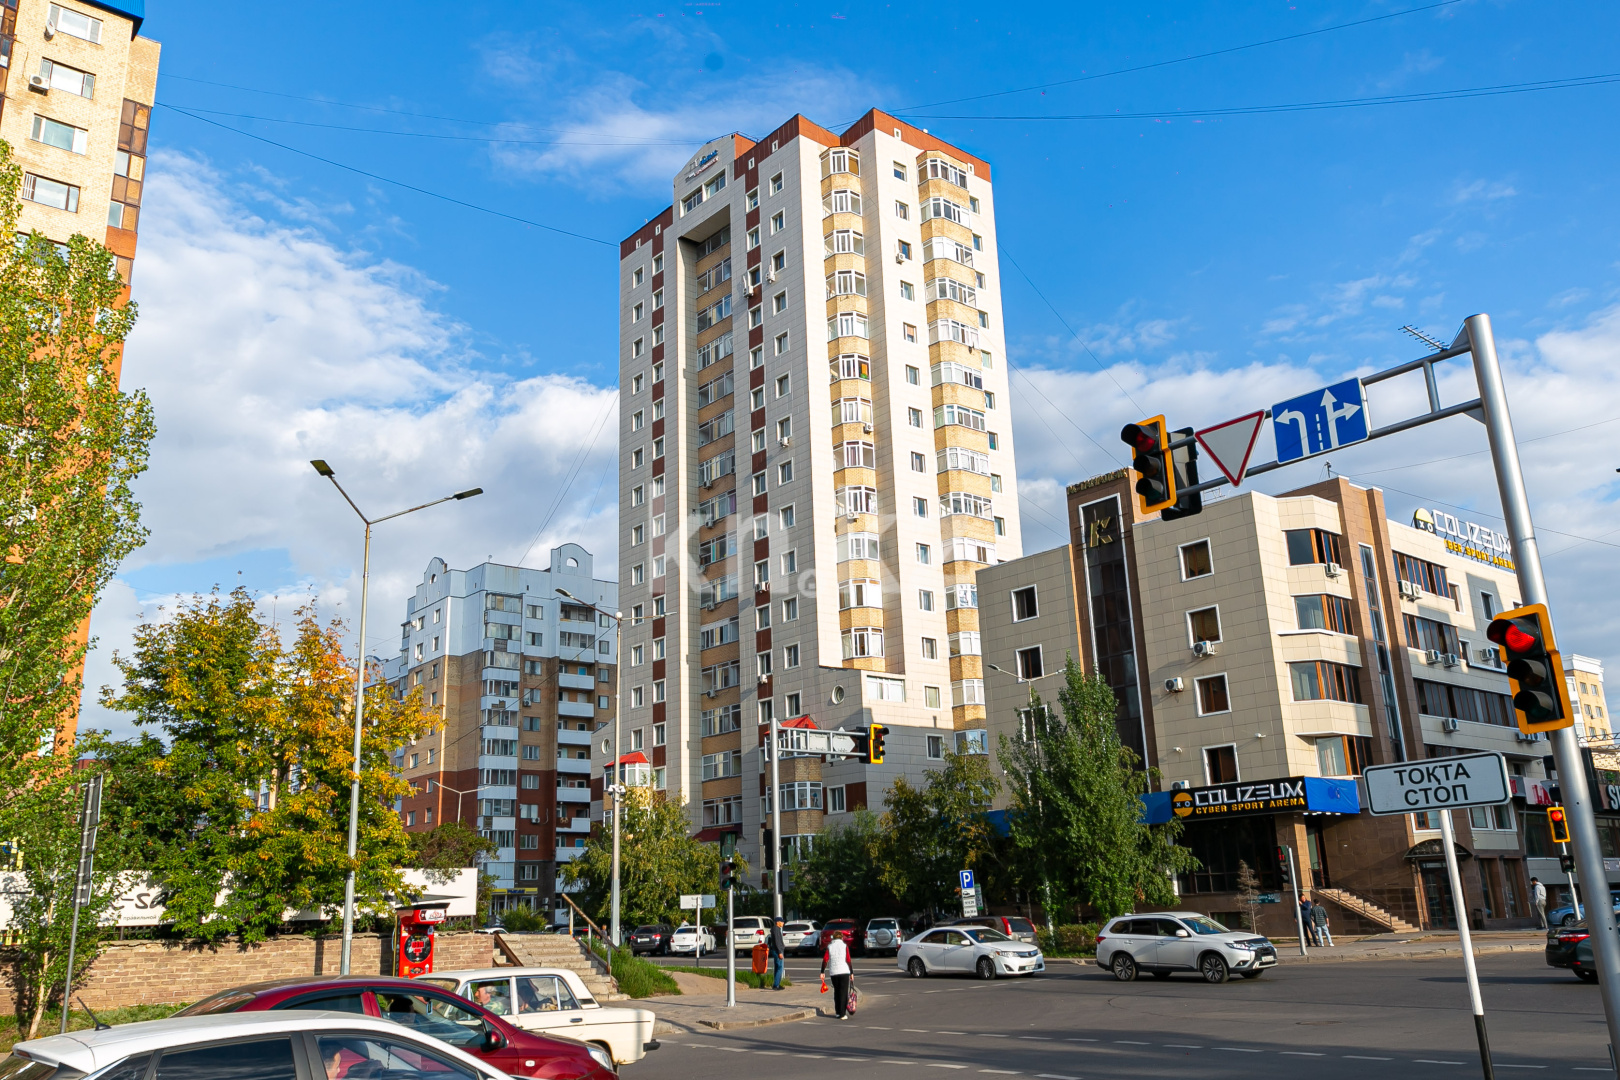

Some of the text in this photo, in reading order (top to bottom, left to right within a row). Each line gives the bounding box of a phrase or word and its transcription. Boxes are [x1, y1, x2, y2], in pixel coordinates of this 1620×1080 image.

[1465, 546, 1490, 562] SPORT
[1394, 762, 1471, 786] ТОҚТА
[1404, 783, 1469, 806] СТОП
[1195, 797, 1305, 815] CYBER SPORT ARENA
[962, 872, 971, 888] P
